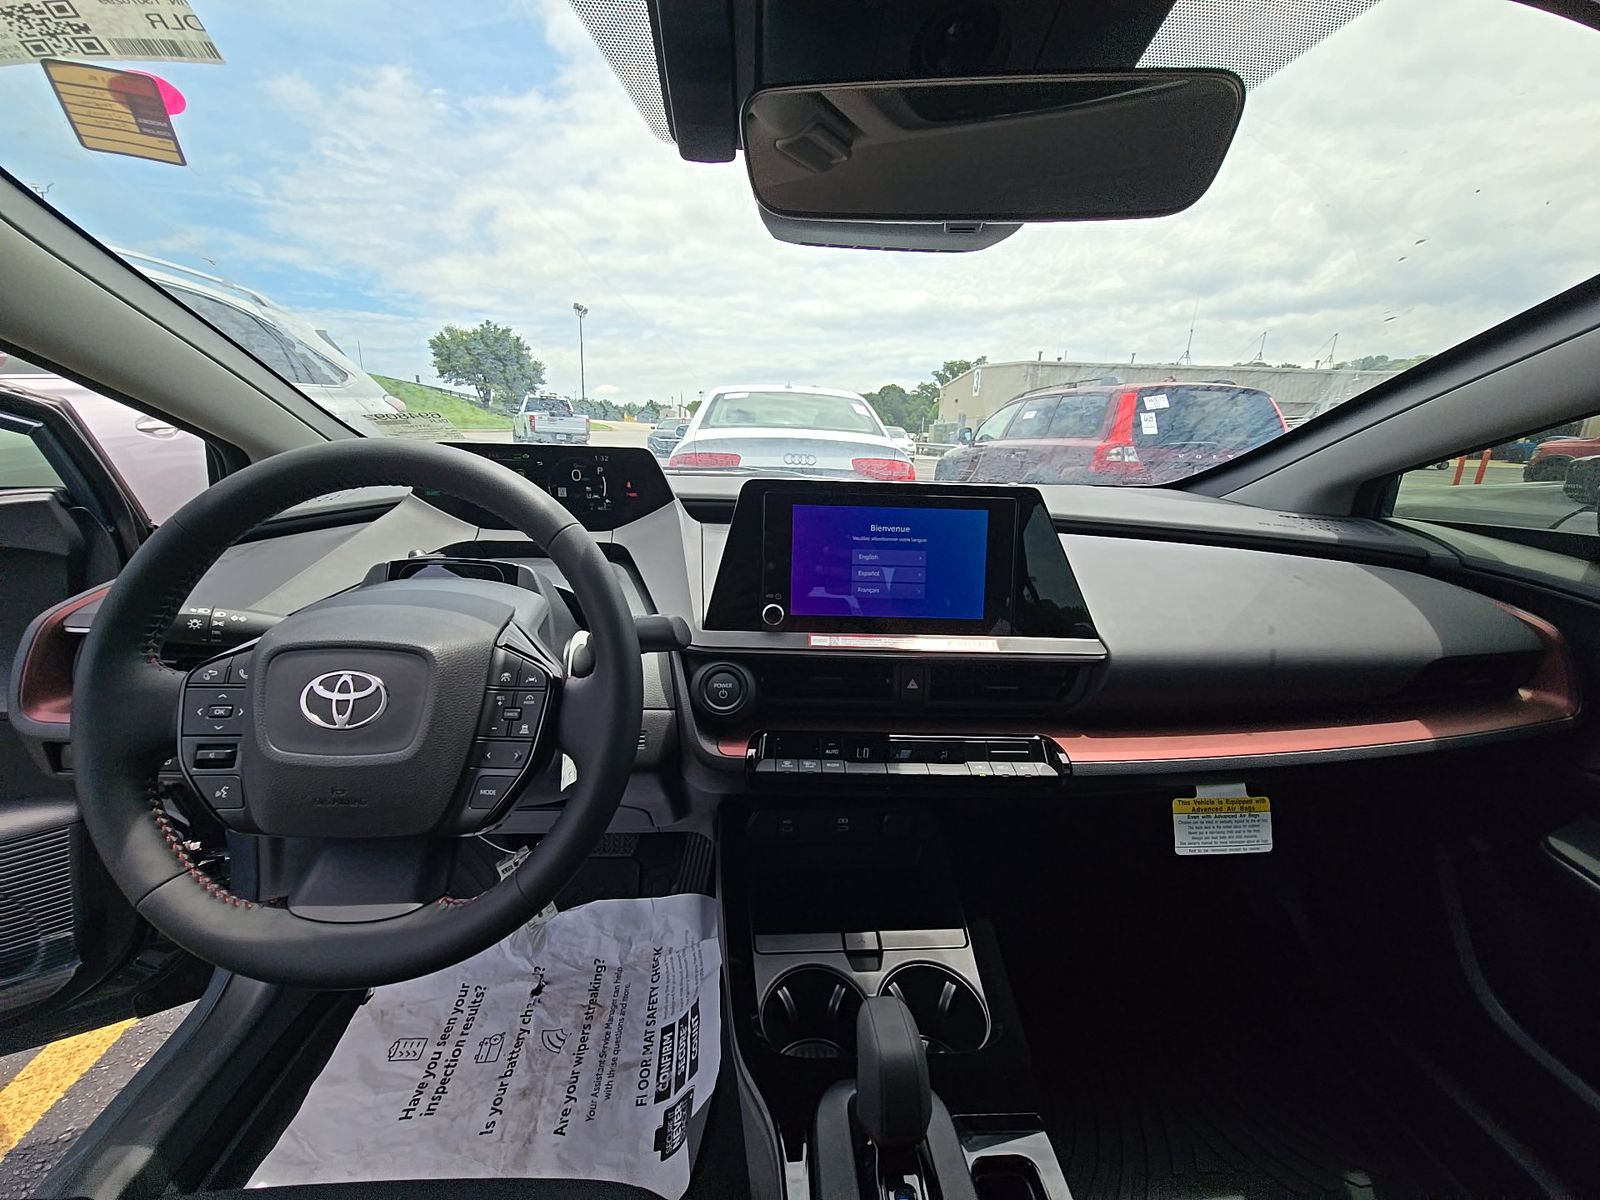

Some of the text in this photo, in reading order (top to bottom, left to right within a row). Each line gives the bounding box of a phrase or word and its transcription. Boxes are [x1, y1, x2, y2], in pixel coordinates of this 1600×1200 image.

[571, 469, 582, 482] 0
[597, 466, 604, 475] P
[870, 524, 911, 533] Bienvenue
[650, 946, 662, 984] CHECK
[646, 986, 659, 1028] SAFETY
[398, 983, 470, 1121] Have you seen your
[419, 985, 487, 1117] inspection results?
[498, 1028, 531, 1079] battery
[552, 958, 606, 1136] Are your wipers streaking?
[585, 966, 624, 1122] Your Assistant Service Manager can help
[604, 1080, 614, 1101] with
[612, 1017, 624, 1056] questions
[642, 1030, 656, 1057] MAT
[658, 1032, 672, 1092] CONFIRM
[488, 1082, 509, 1116] your
[479, 1120, 496, 1136] Is
[672, 1102, 682, 1150] NEVER
